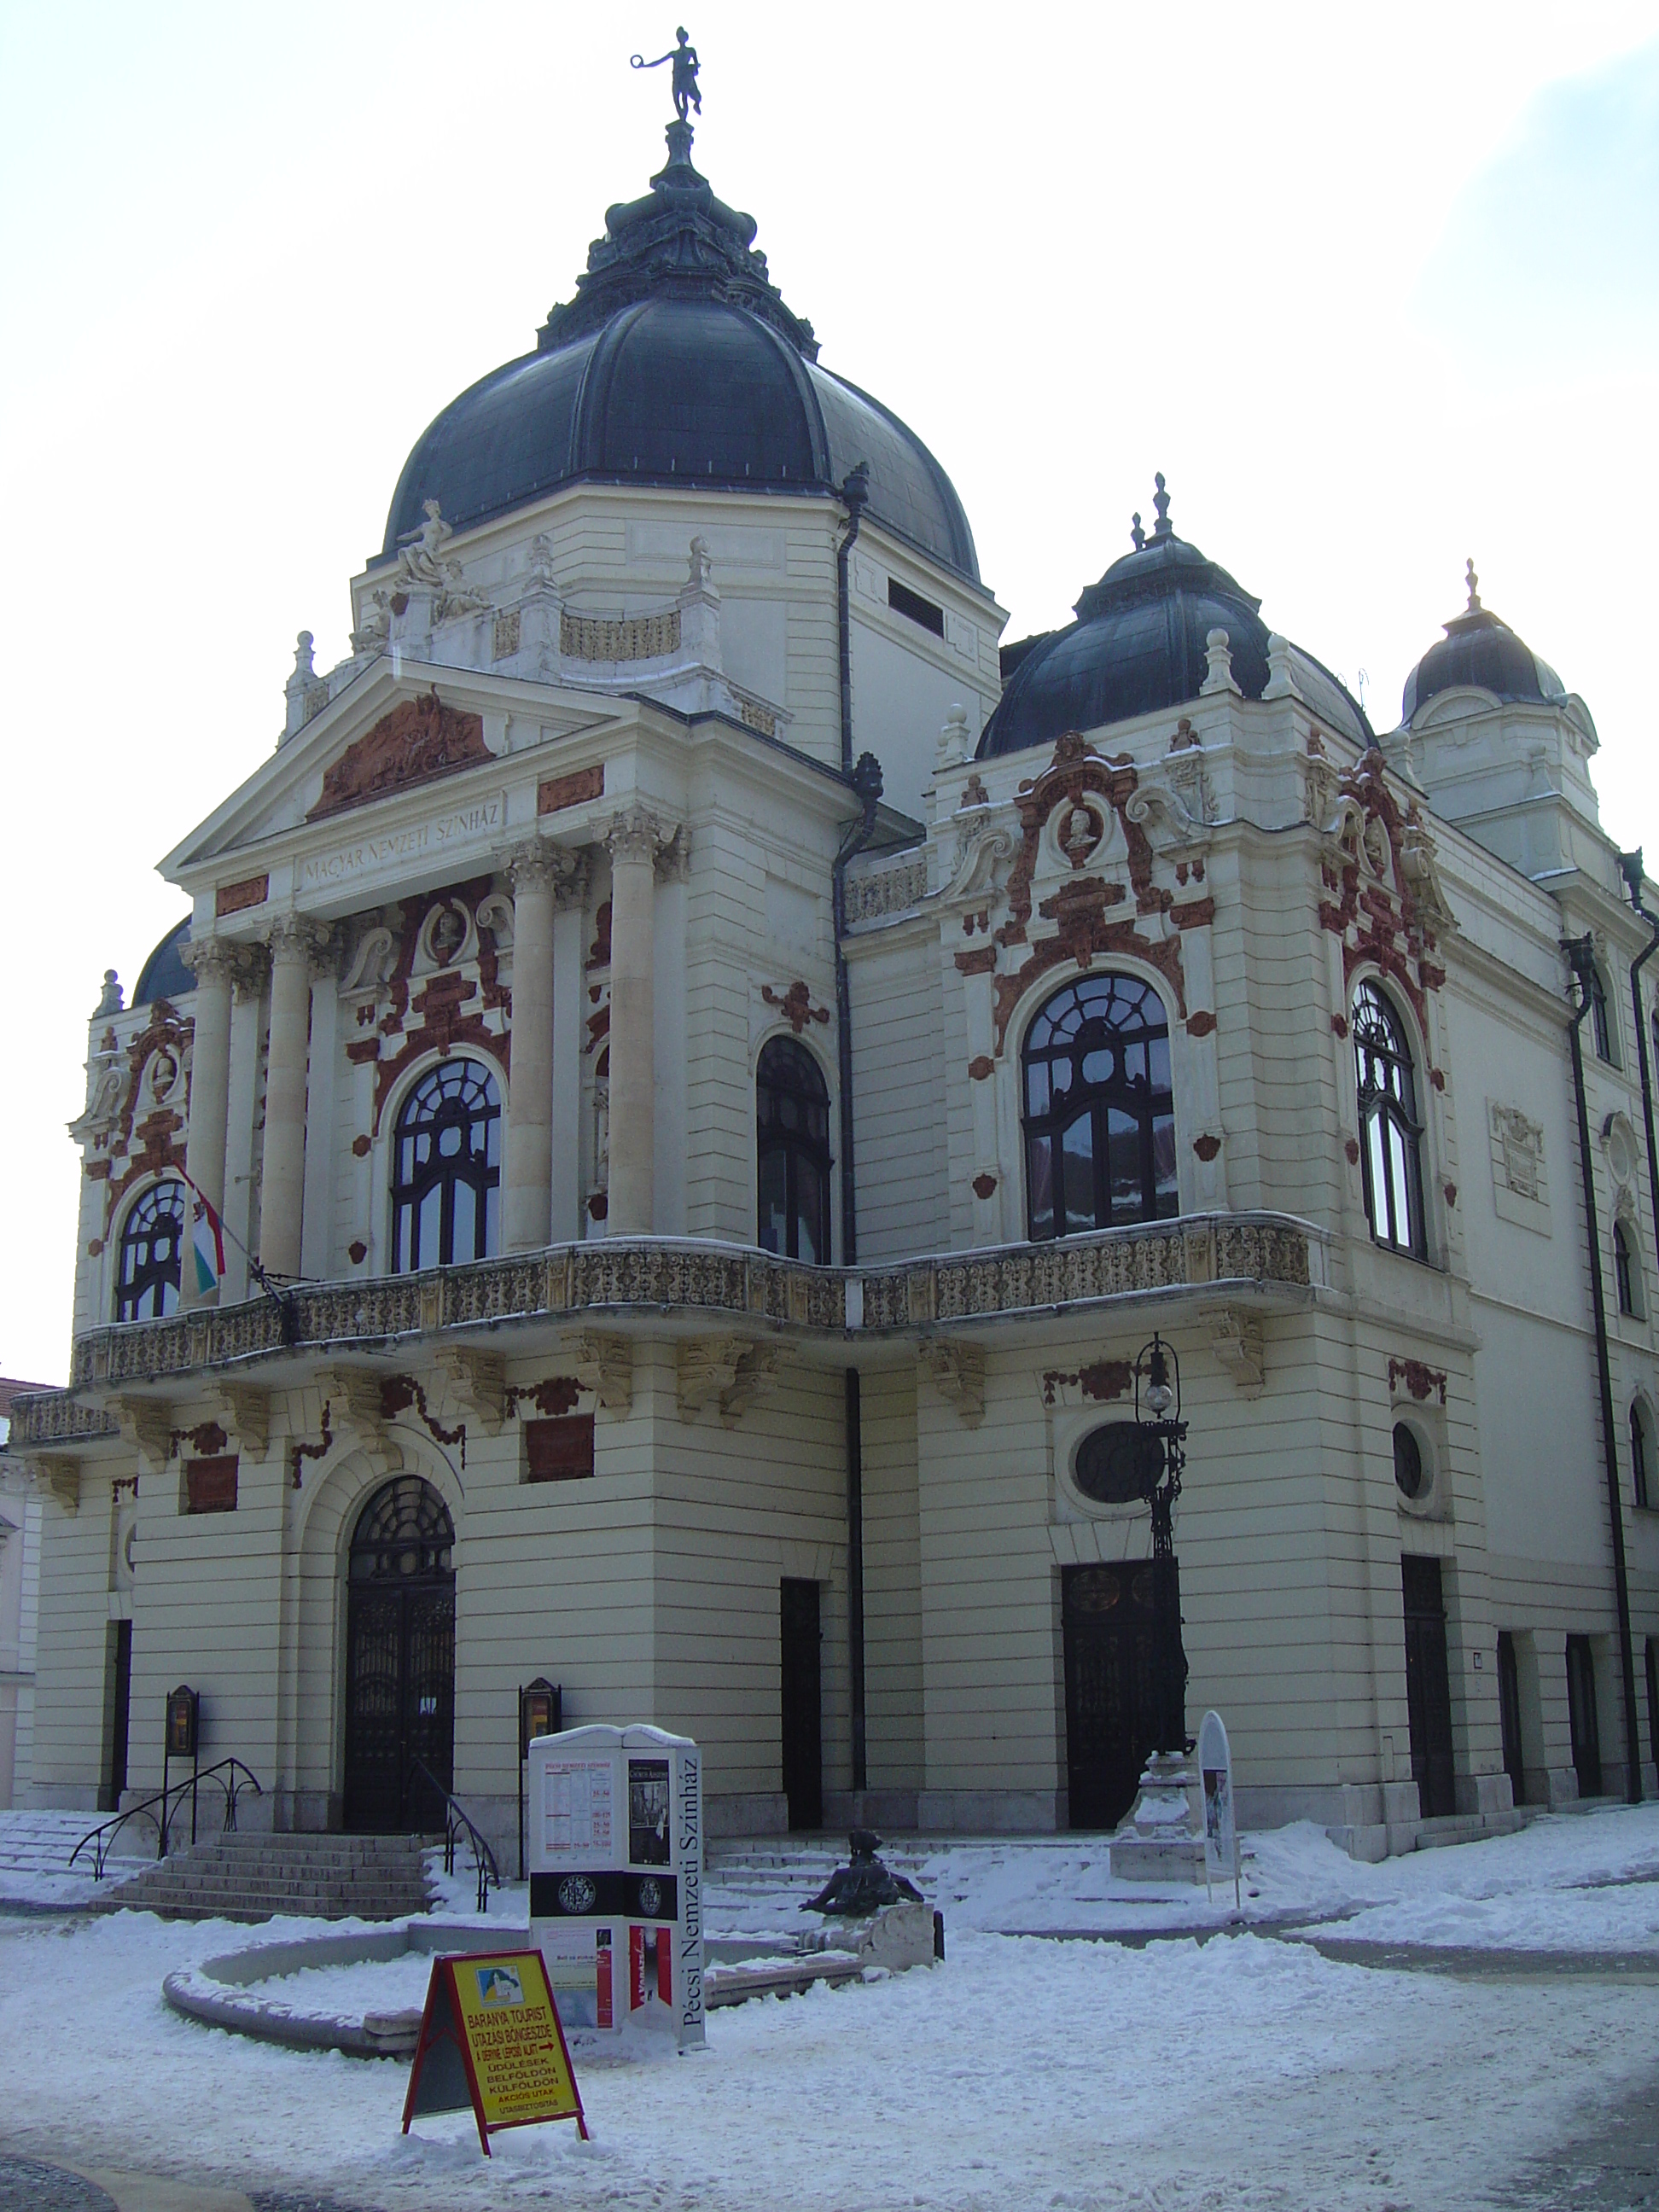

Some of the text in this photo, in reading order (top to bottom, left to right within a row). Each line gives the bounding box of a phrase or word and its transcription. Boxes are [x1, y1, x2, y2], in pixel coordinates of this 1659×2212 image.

[305, 804, 498, 881] MAGYAR NEMZETI SZÍNHÁZ
[678, 1758, 701, 2027] Pécsi Nemzeti Színház
[468, 2006, 546, 2029] BARANYA TOURIST
[471, 2027, 504, 2047] UTAZÁSI
[532, 2088, 556, 2098] UTAK
